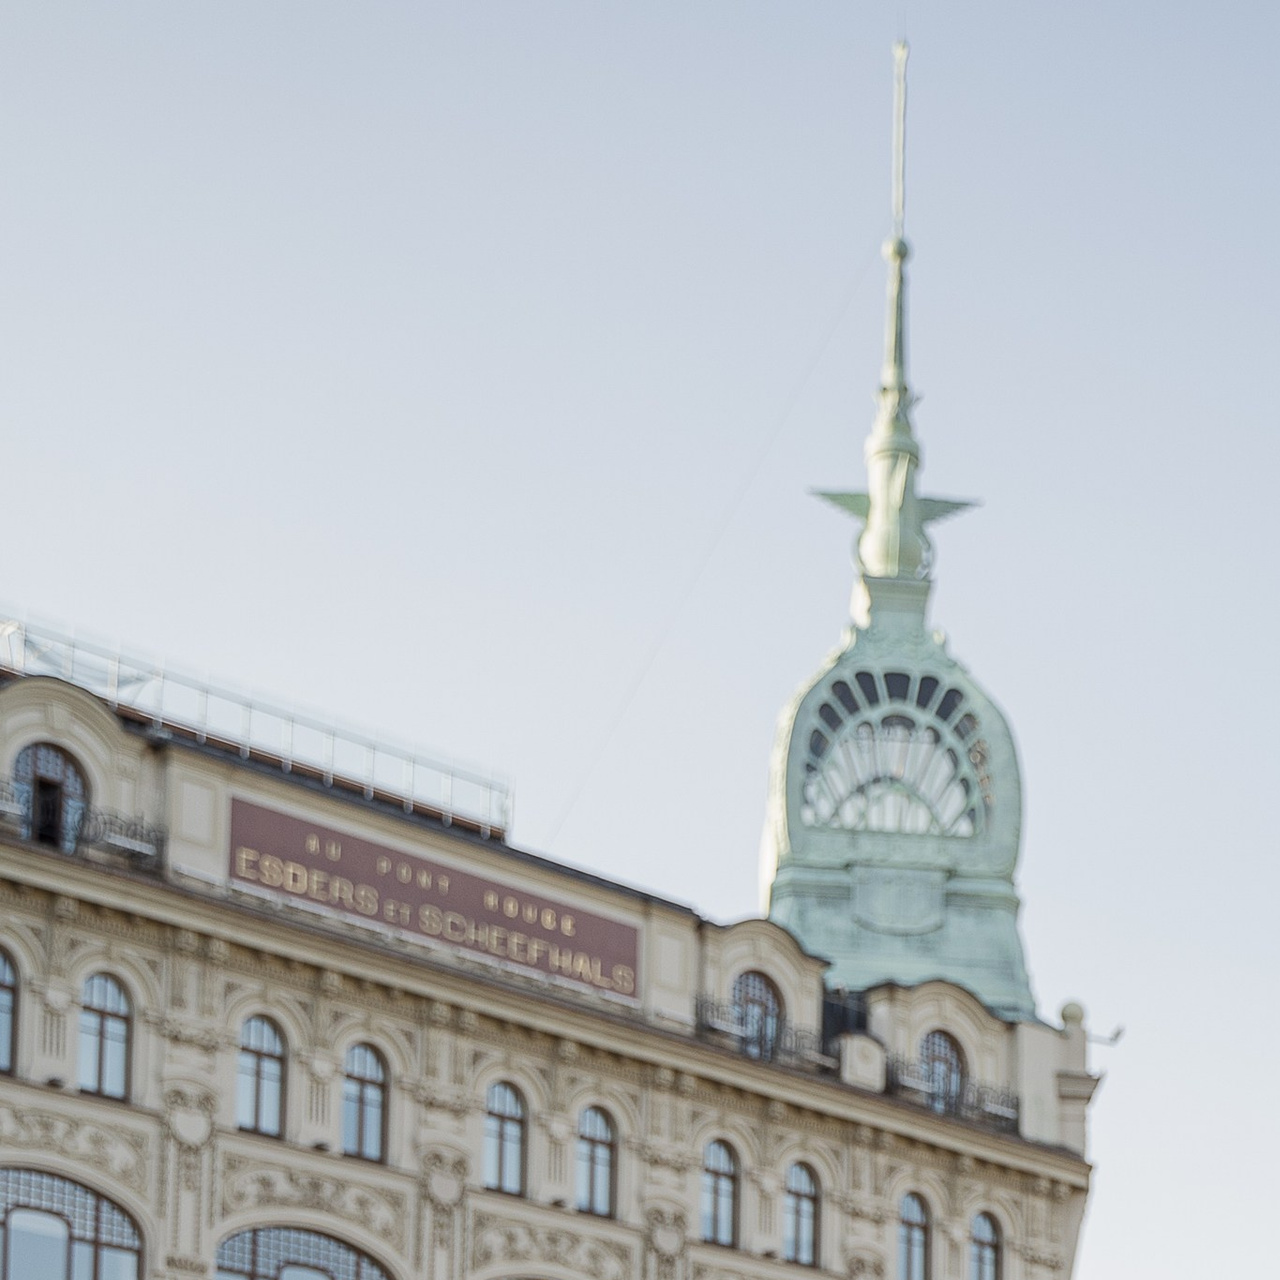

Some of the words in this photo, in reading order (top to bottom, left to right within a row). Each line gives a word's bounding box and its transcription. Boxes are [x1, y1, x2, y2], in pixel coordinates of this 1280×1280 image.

[306, 833, 342, 861] AU
[377, 856, 449, 896] PONT
[234, 846, 379, 917] ESDERS
[418, 904, 635, 994] SCHEEFHALS
